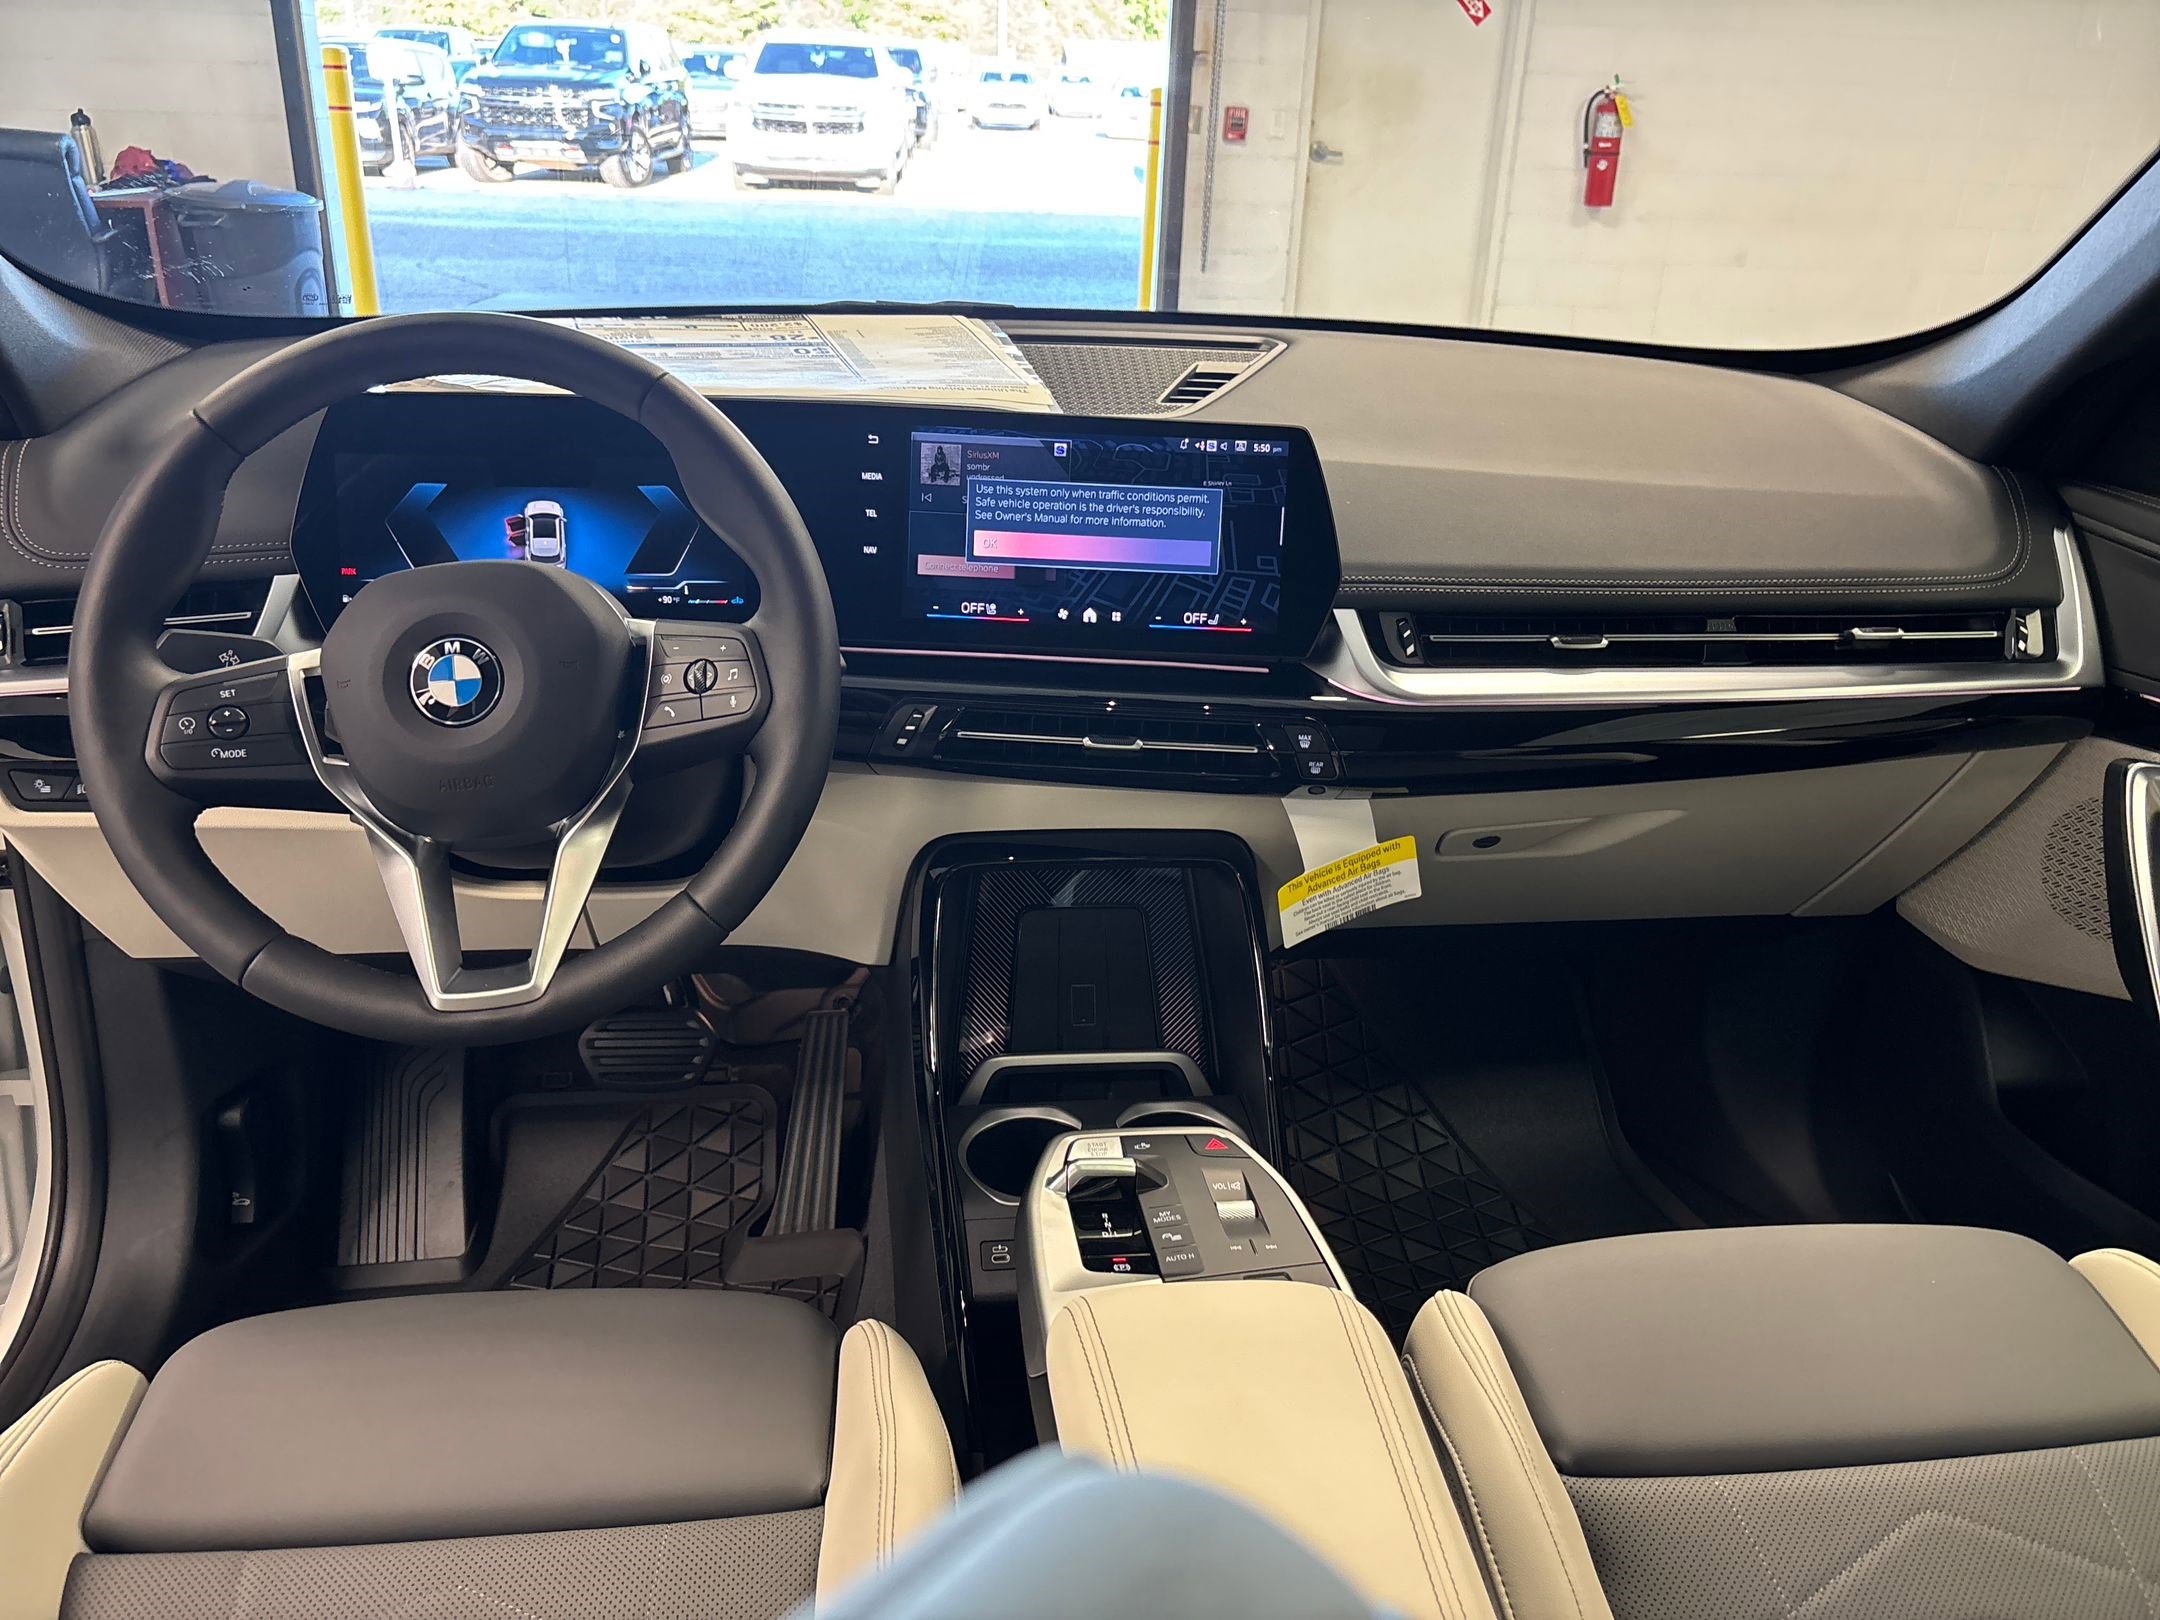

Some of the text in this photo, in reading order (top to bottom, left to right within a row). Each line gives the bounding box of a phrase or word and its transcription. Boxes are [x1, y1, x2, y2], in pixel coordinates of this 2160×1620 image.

[1253, 443, 1271, 452] 5:50
[966, 450, 1000, 460] SiriusXM
[966, 463, 991, 472] sombr
[862, 472, 883, 480] MEDIA
[976, 484, 1210, 504] Use this system only when traffic conditions permit.
[976, 497, 995, 507] Safe
[998, 498, 1030, 509] vehicle
[1033, 500, 1076, 511] operation
[1080, 502, 1086, 512] is
[1089, 503, 1104, 512] the
[1107, 504, 1140, 514] driver's
[1142, 506, 1205, 518] responsibility.
[865, 509, 877, 517] TEL
[975, 510, 1166, 528] See Owner's Manual for more information.
[983, 539, 997, 549] OK
[863, 546, 877, 554] NAV
[925, 560, 999, 574] Connect telephone
[961, 602, 985, 614] OFF
[1184, 612, 1208, 624] OFF
[418, 641, 490, 670] BMW
[220, 689, 236, 698] SET
[220, 749, 247, 758] MODE
[1288, 881, 1303, 893] This
[1303, 868, 1334, 884] Vehicle
[1343, 848, 1381, 868] Equipped
[1383, 842, 1401, 853] with
[1307, 860, 1381, 894] Advanced Air Bags
[1302, 866, 1390, 906] Even with Advanced Air Bags
[1153, 1215, 1181, 1223] MODES
[1166, 1253, 1187, 1262] AUTO
